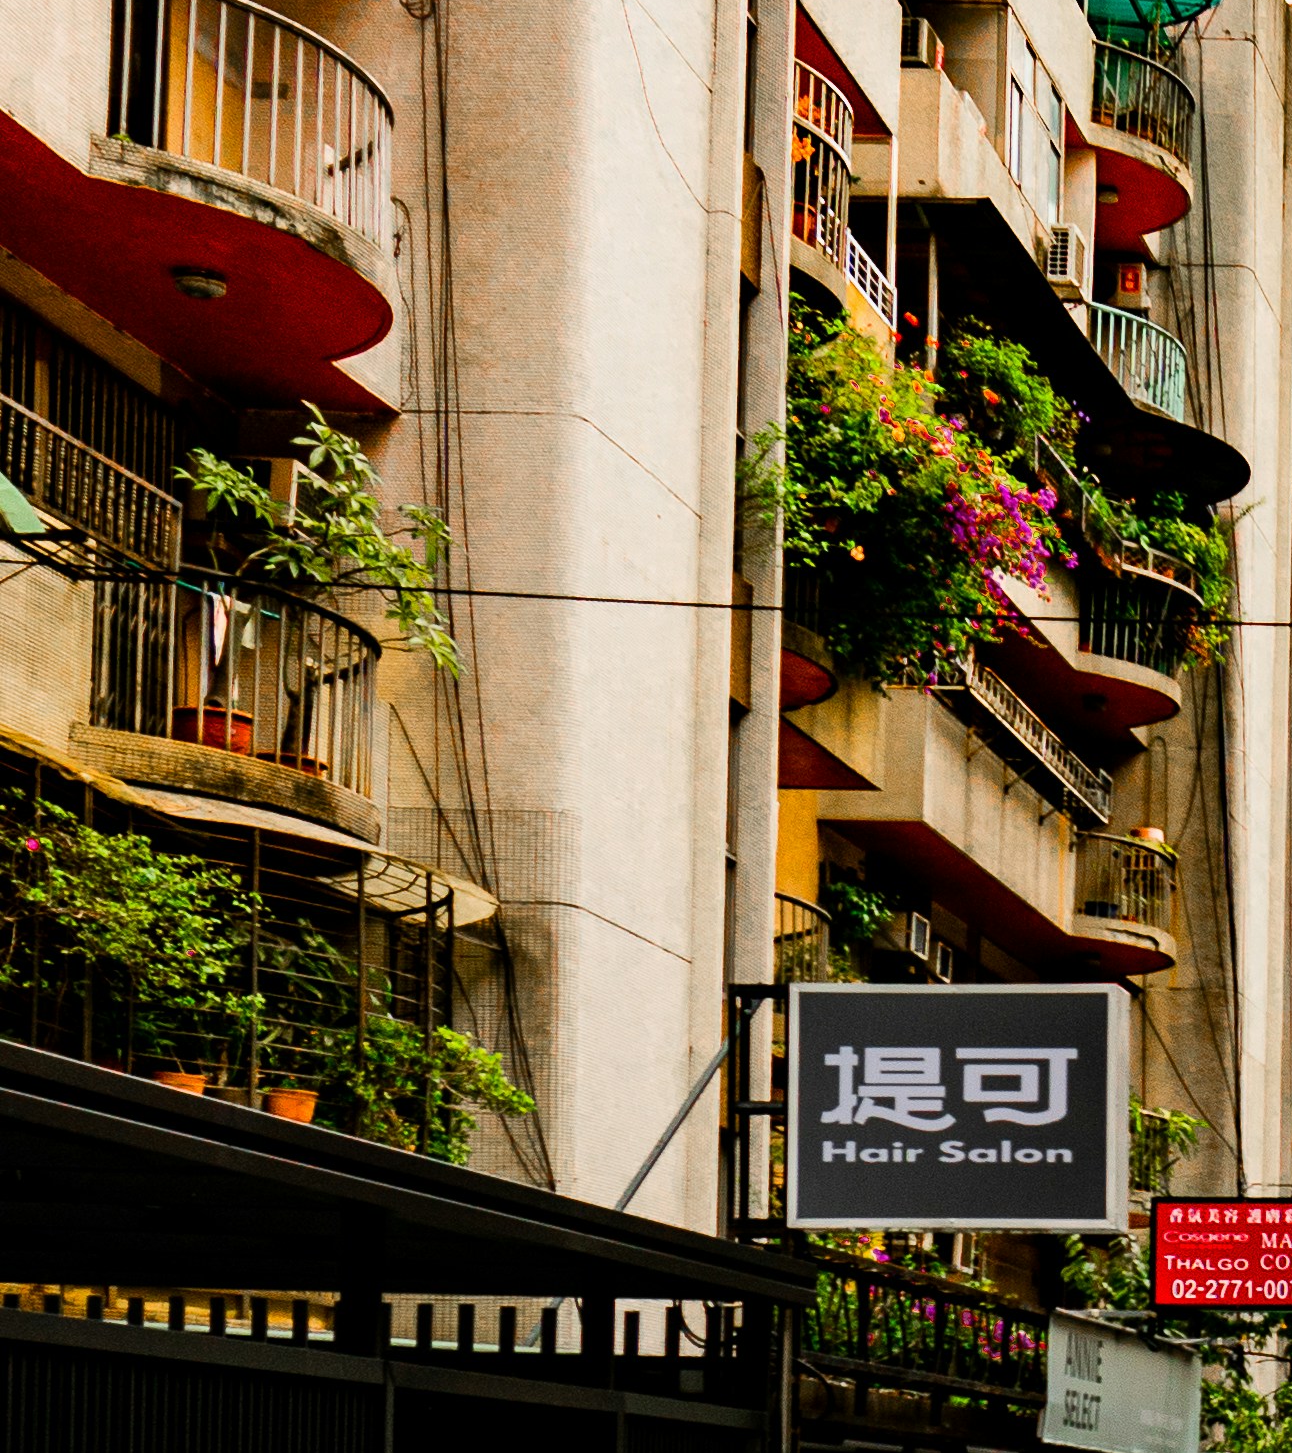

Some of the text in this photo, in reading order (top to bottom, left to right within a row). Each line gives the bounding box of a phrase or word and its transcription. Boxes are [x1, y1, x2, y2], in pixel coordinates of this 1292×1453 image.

[820, 1046, 1079, 1133] 提可
[822, 1140, 1074, 1163] Hair Salon
[1163, 1254, 1250, 1271] THALGO
